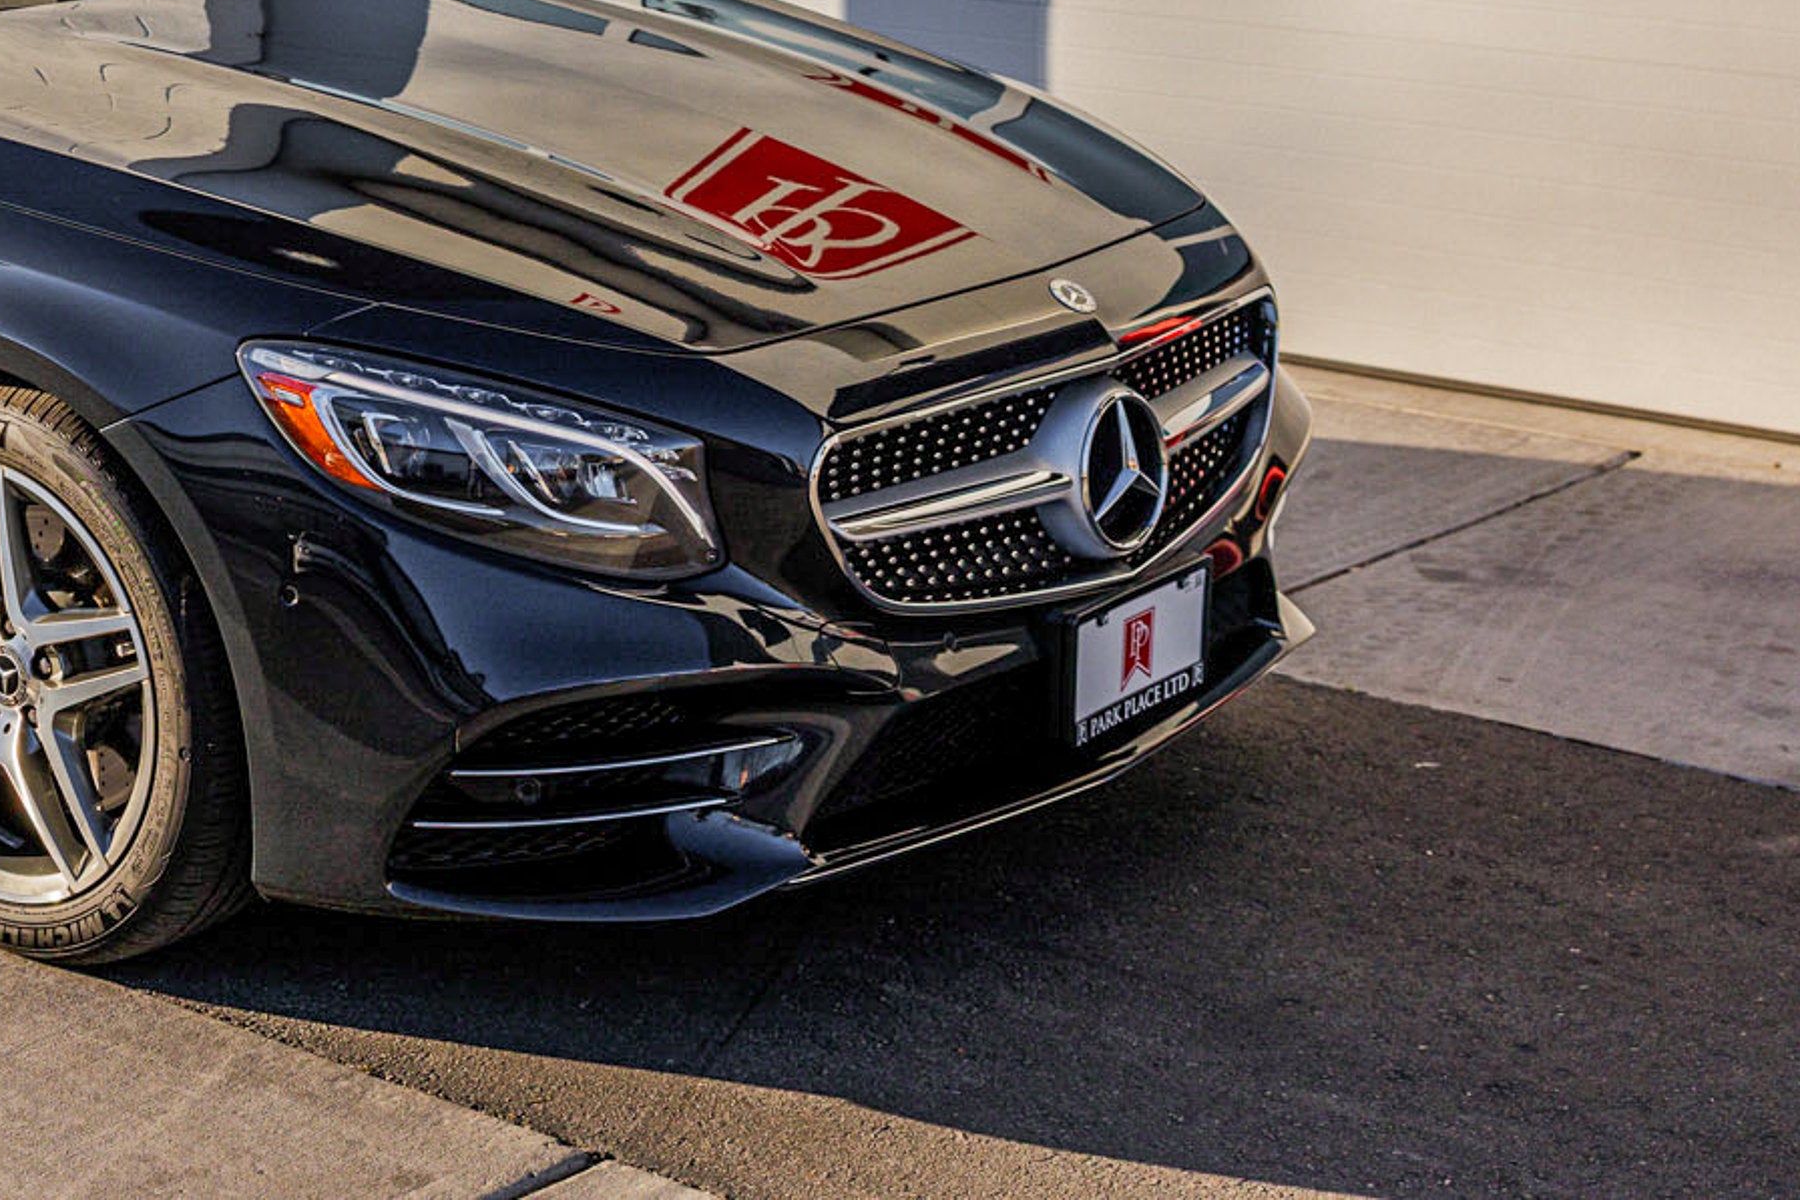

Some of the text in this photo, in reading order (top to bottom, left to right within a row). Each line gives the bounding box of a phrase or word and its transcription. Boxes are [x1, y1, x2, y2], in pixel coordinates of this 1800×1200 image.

[1089, 703, 1123, 738] PARK
[1124, 684, 1162, 719] PLACE
[1164, 671, 1190, 699] LTD
